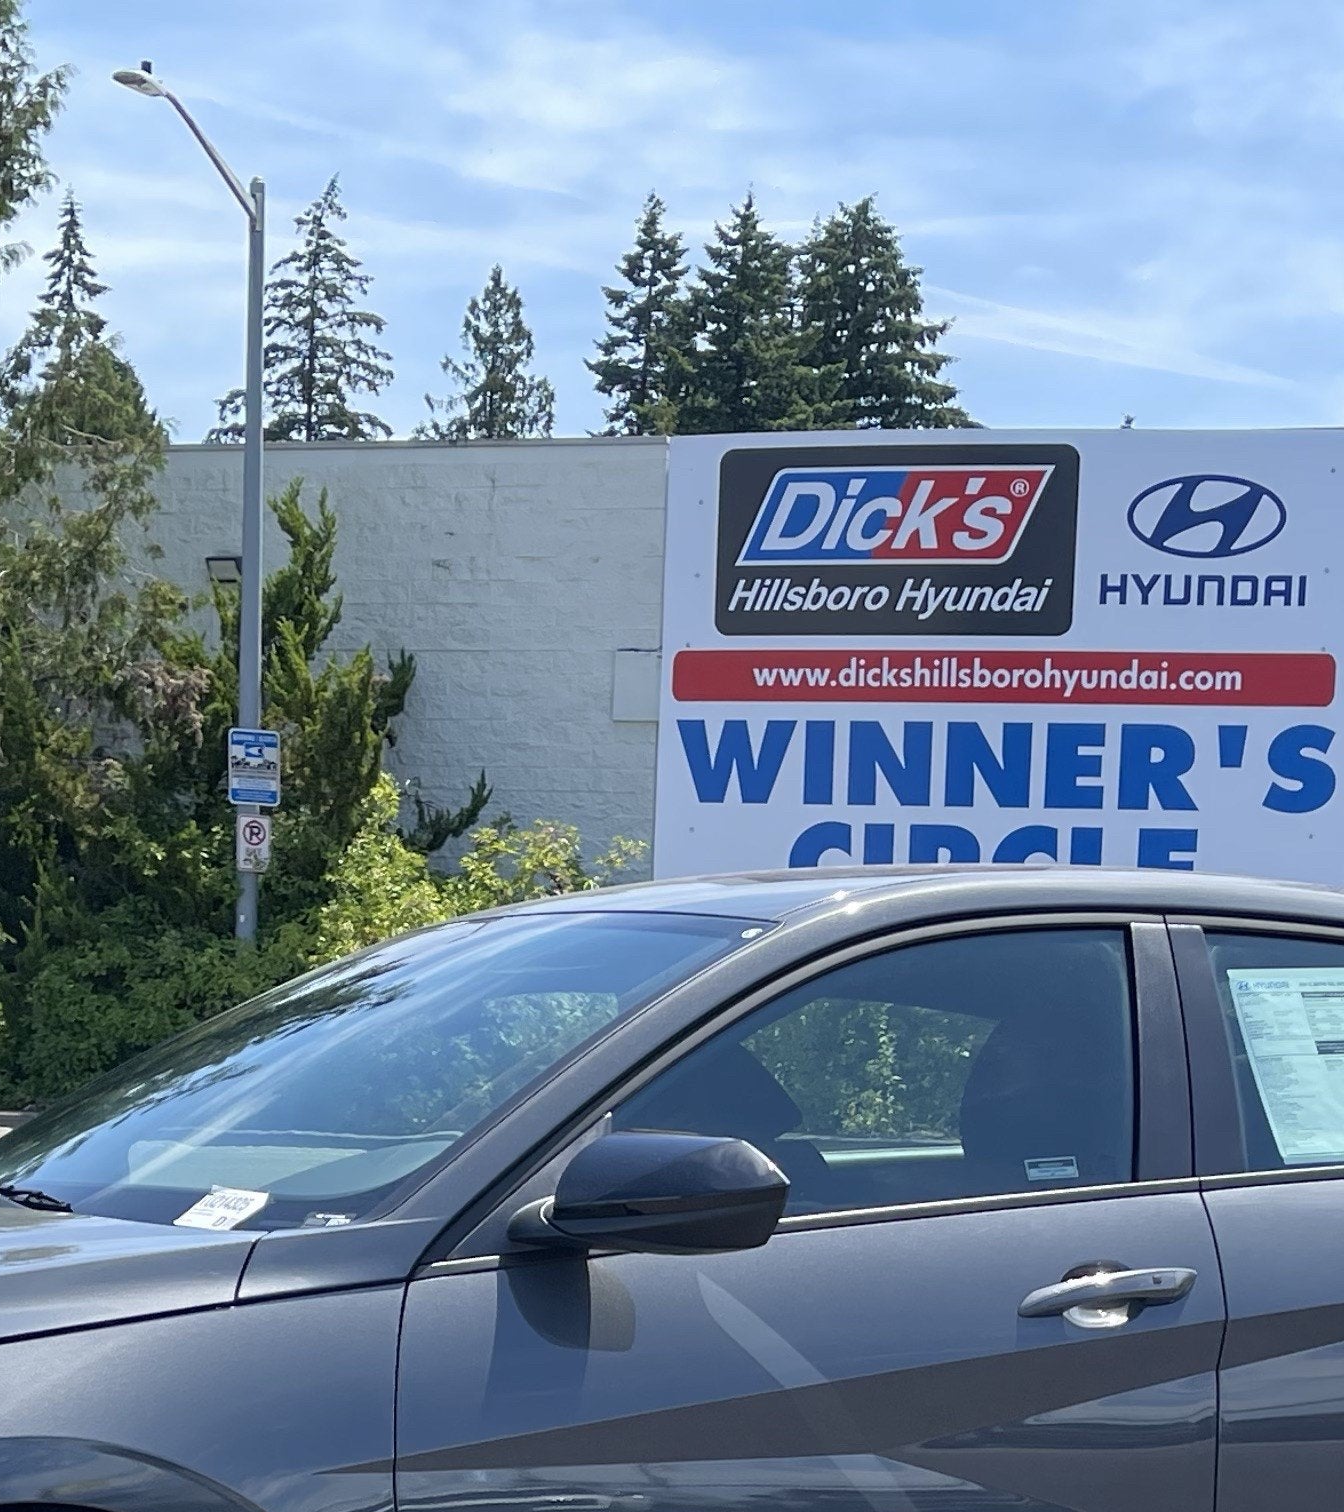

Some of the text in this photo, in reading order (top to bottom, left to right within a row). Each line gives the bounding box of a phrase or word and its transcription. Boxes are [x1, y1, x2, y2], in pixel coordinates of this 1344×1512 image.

[727, 577, 1054, 620] Hillsboro Hyundai
[1099, 573, 1308, 607] HYUNDAI
[752, 656, 1243, 698] www.dickshillsborohyundai.com
[676, 718, 1337, 815] WINNER'S
